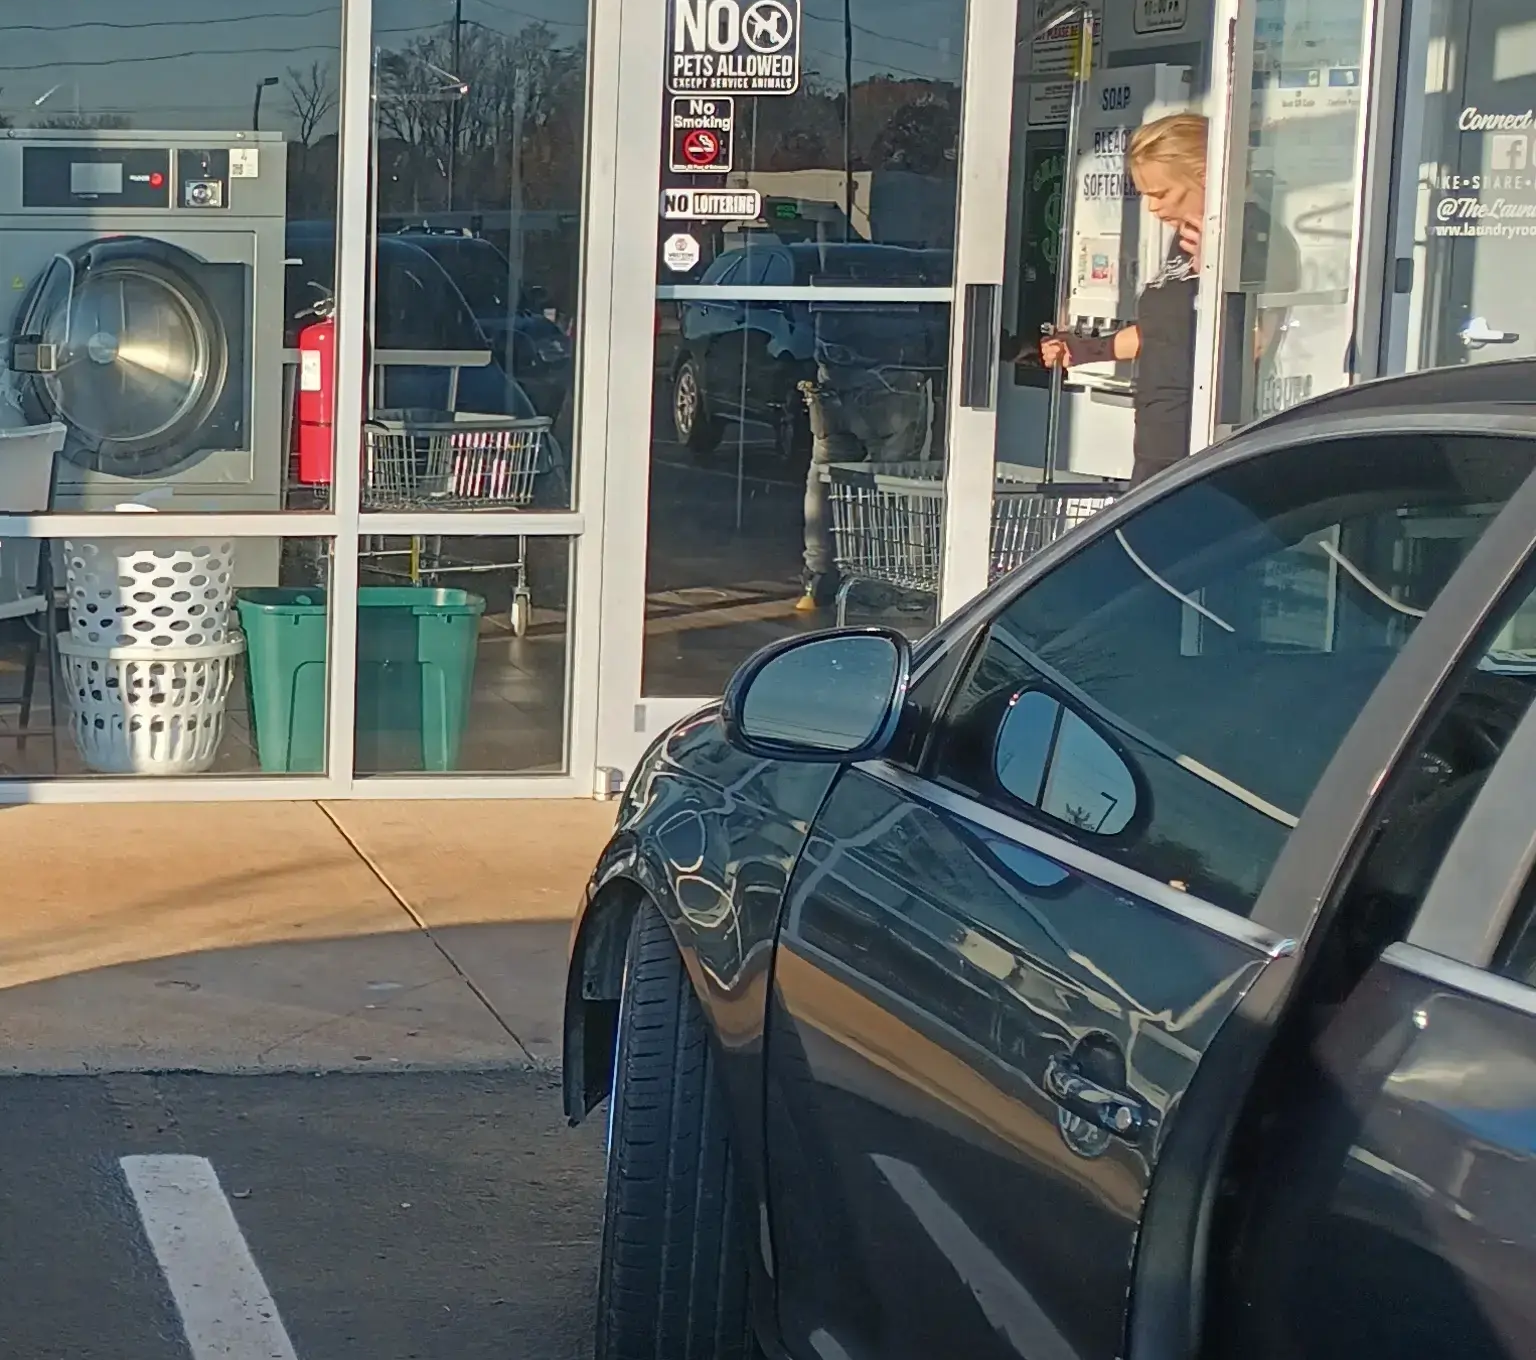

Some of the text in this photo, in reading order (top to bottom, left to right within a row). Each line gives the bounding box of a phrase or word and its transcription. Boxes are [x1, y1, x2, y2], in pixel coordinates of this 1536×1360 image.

[674, 0, 740, 53] NO
[673, 54, 793, 77] PETS ALLOWED
[672, 77, 792, 89] EXCEPT SERVICE ANIMALS
[689, 100, 716, 116] No
[1101, 87, 1131, 111] SOAP
[674, 116, 731, 132] Smoking
[1458, 107, 1533, 131] Connect
[1472, 175, 1523, 190] SHARE
[665, 195, 689, 213] NO
[694, 194, 756, 214] LOITERING
